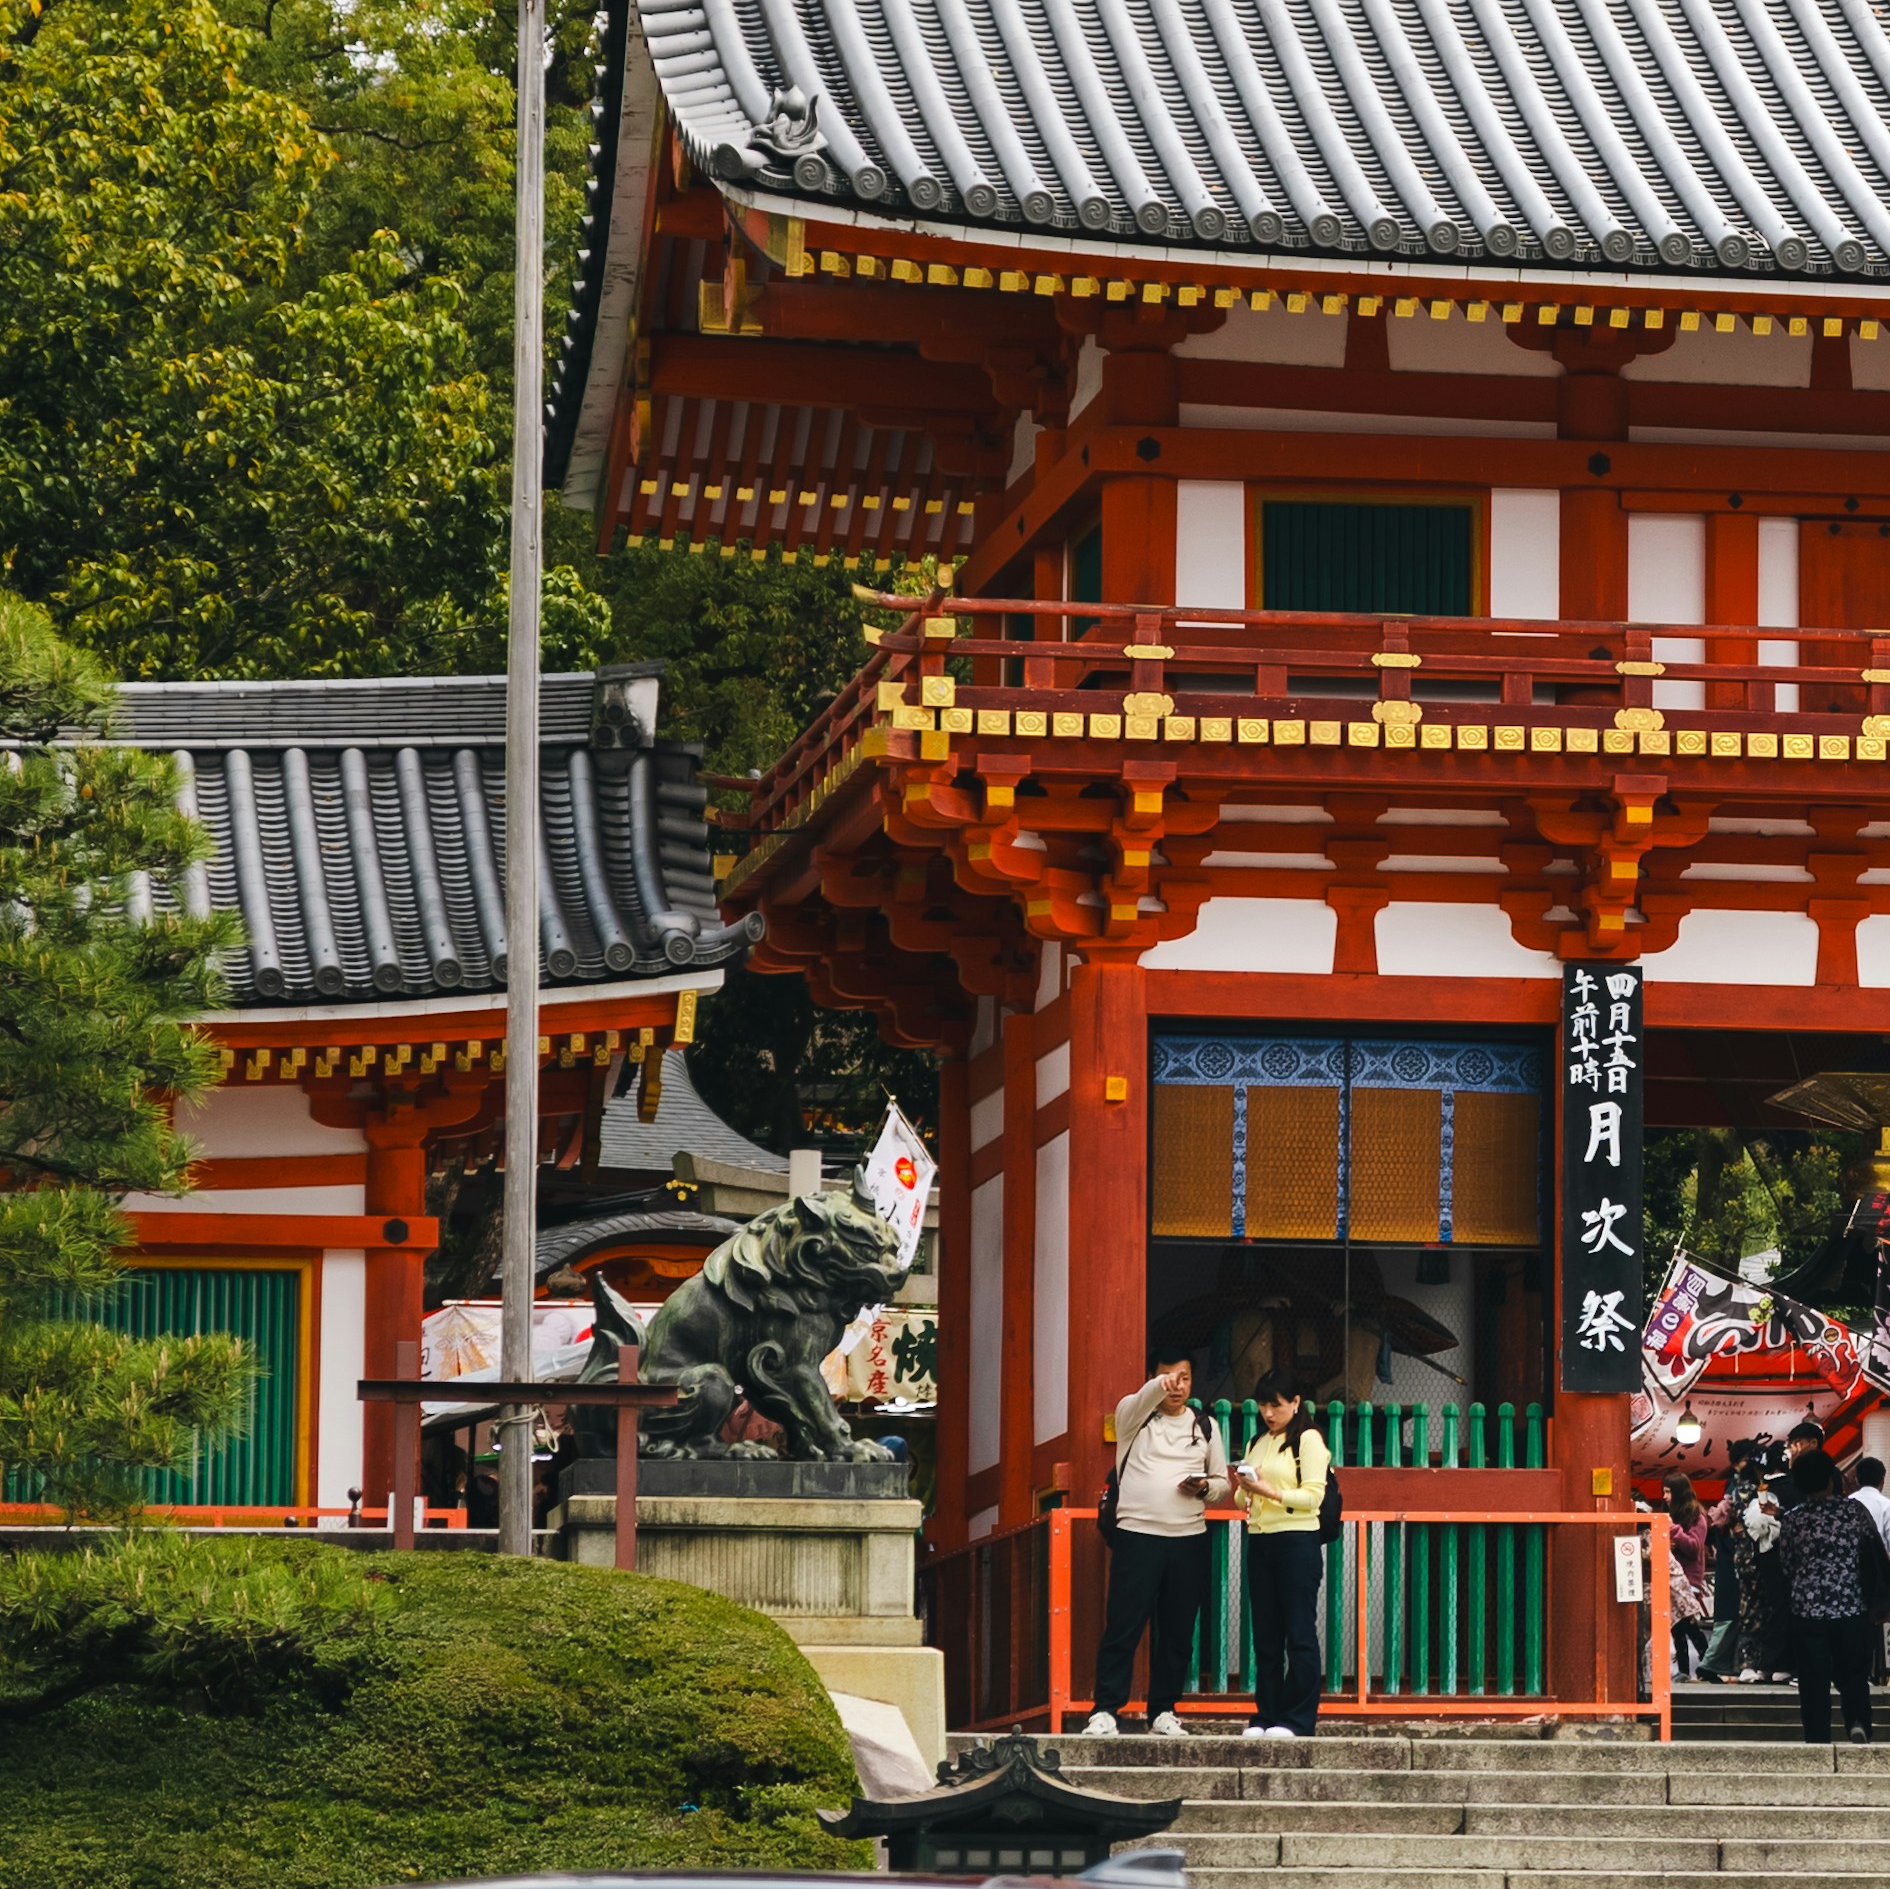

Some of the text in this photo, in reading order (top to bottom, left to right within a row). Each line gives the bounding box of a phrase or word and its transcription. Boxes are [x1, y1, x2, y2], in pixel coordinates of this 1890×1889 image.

[1570, 969, 1602, 1092] 午前十時
[1602, 973, 1638, 1093] 四月十五日
[1576, 1101, 1636, 1352] 月次祭
